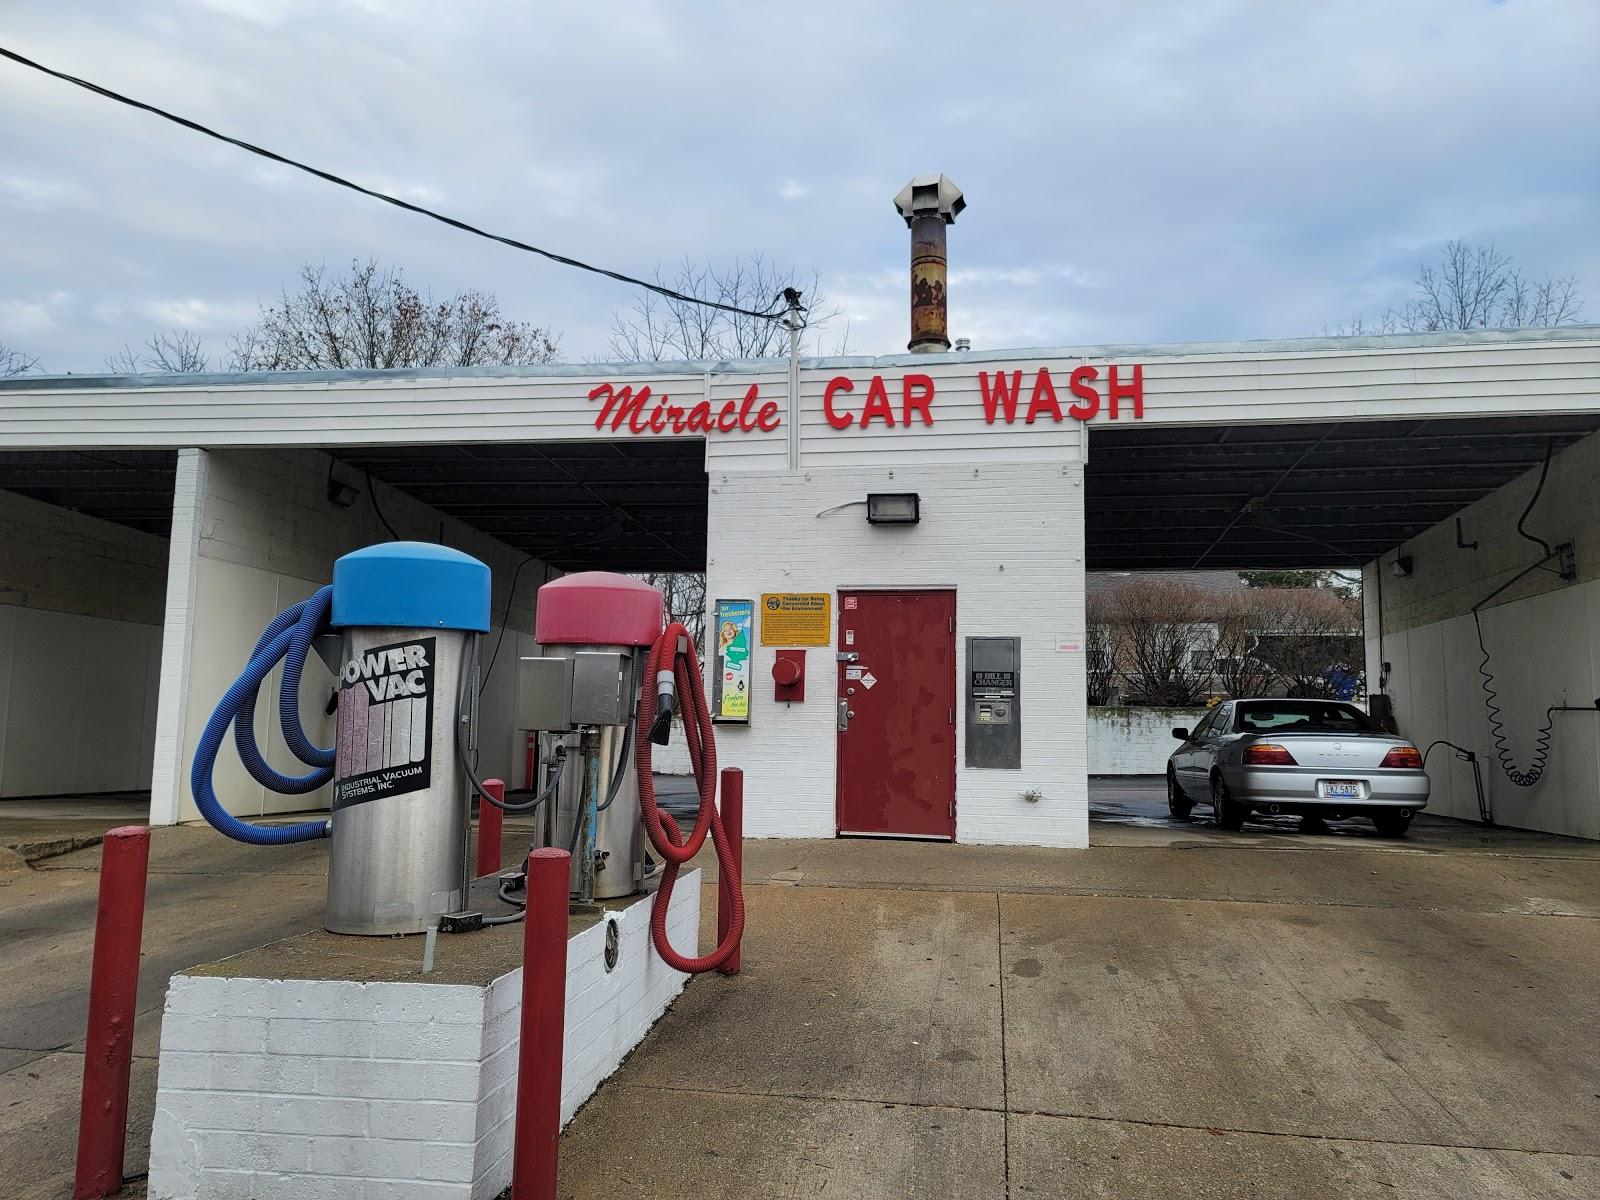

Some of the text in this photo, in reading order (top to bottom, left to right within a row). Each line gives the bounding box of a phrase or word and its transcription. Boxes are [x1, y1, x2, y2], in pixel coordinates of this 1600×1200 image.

[589, 364, 1143, 434] Miracle CAR WASH
[366, 670, 426, 701] VAC
[974, 679, 1013, 687] CHANGER
[341, 766, 423, 791] INDUSTRIAL VACUUM
